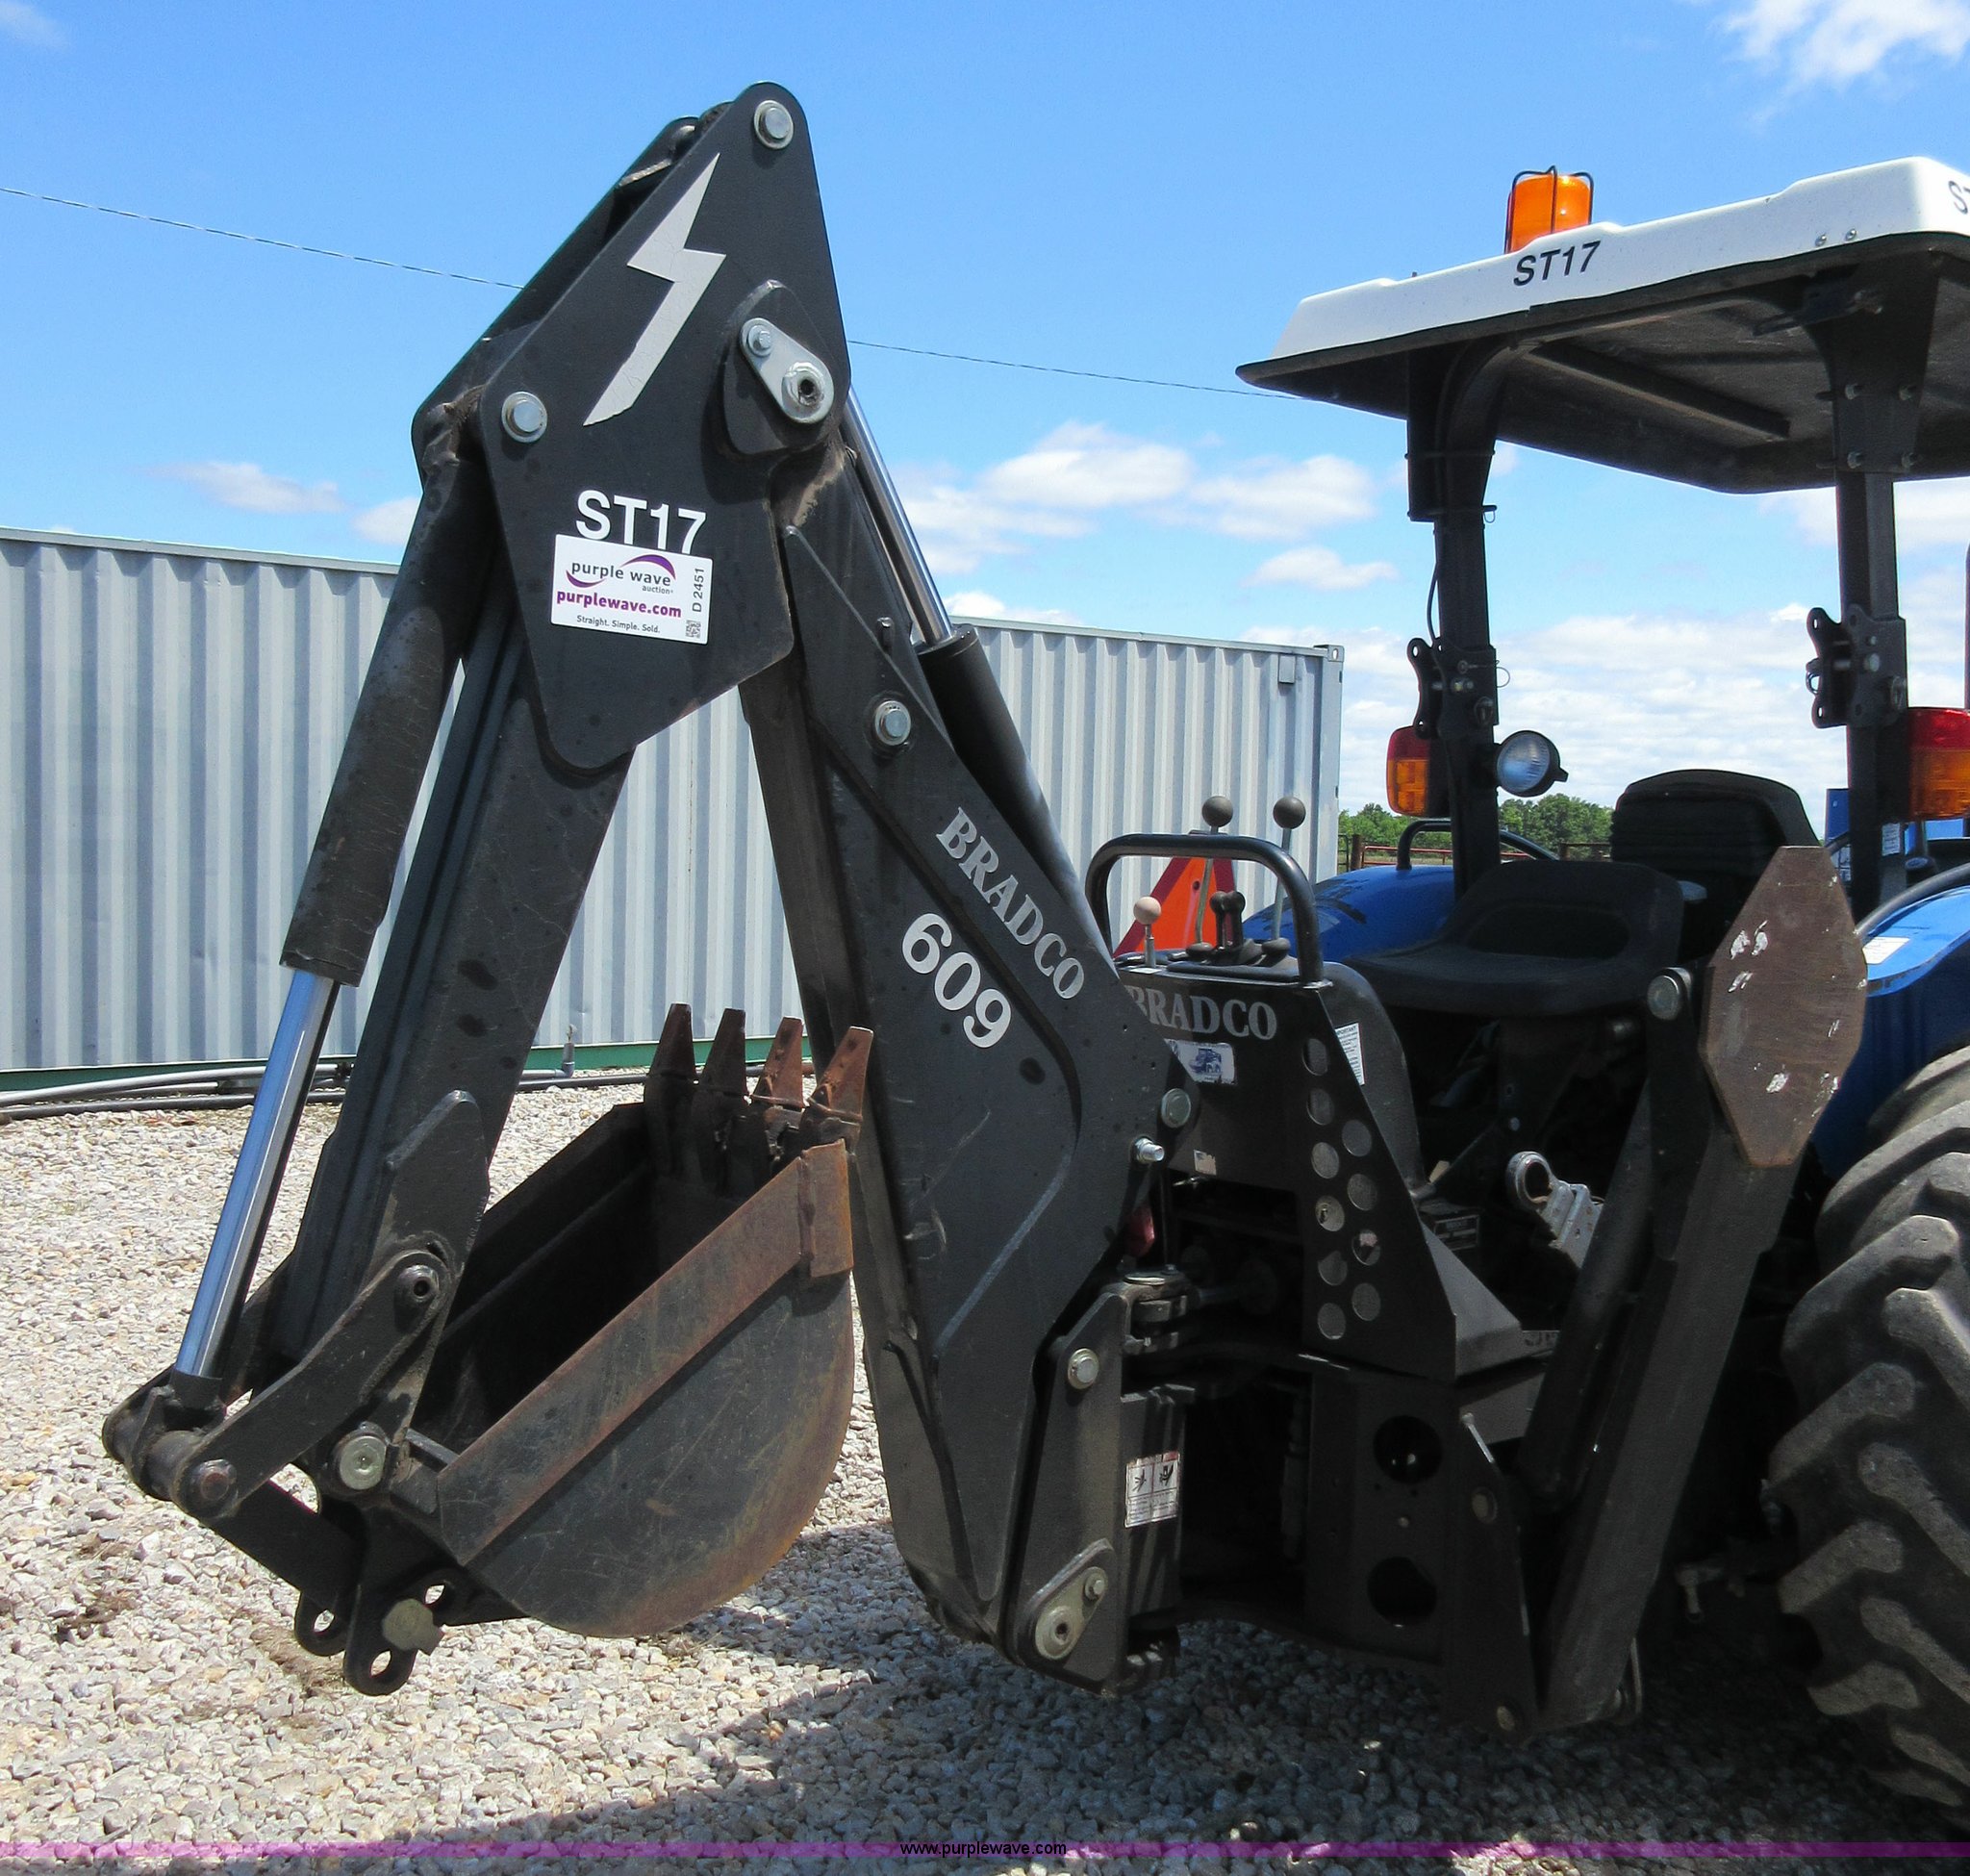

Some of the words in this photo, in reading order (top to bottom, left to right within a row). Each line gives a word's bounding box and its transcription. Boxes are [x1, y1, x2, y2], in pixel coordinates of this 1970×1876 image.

[1948, 180, 1970, 215] S
[1513, 240, 1601, 287] ST17
[575, 489, 706, 555] ST17
[571, 562, 624, 579] purple
[630, 570, 671, 586] wave
[693, 568, 705, 600] 2451
[556, 590, 682, 618] purplewave.com
[576, 615, 610, 627] Straight.
[612, 621, 640, 631] Simple.
[642, 624, 661, 633] Sold.
[935, 806, 1084, 1000] BRADCO
[902, 913, 1011, 1049] 609
